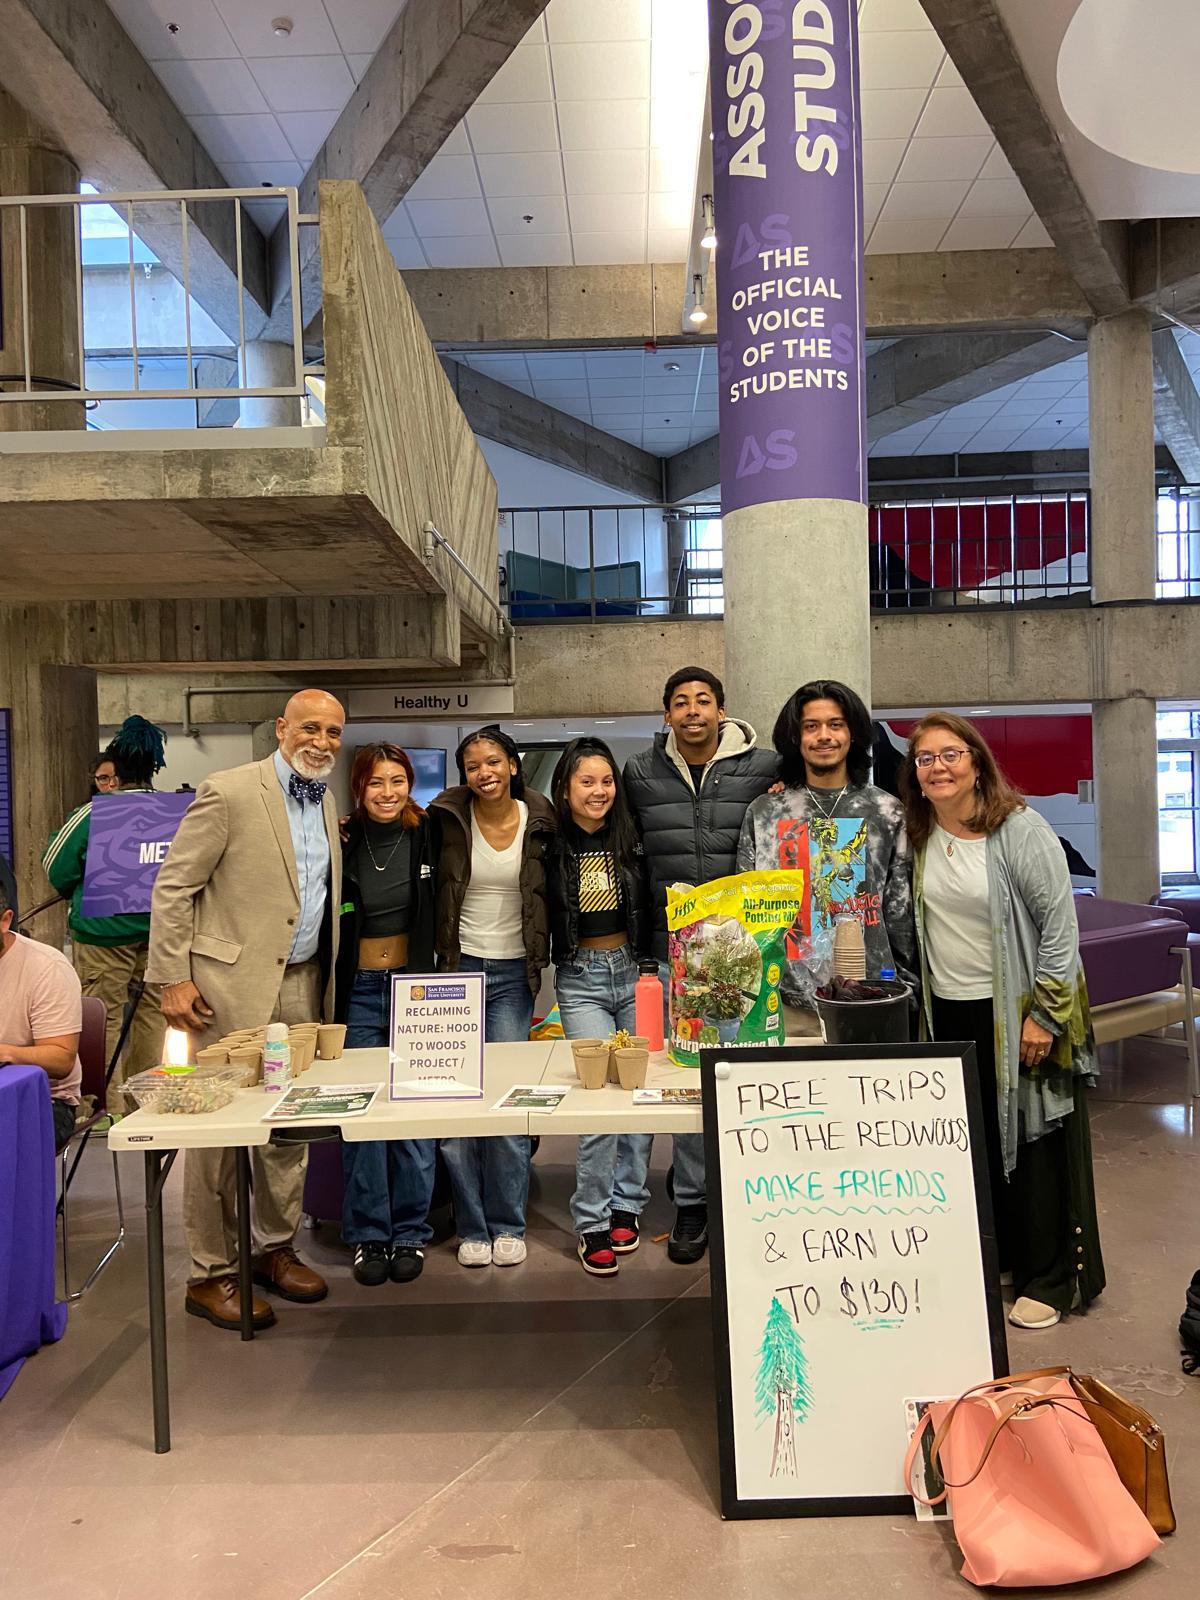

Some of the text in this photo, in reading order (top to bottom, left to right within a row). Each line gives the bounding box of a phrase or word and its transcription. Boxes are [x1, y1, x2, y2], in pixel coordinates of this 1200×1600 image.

[724, 0, 767, 179] ASSO
[758, 246, 809, 271] THE
[731, 277, 842, 311] OFFICIAL
[747, 308, 825, 335] VOICE
[742, 344, 774, 367] OF
[782, 339, 832, 360] THE
[730, 369, 848, 403] STUDENTS
[394, 694, 469, 710] Healthy U
[671, 898, 697, 920] Jiffy
[743, 898, 800, 910] All-Purpose
[745, 911, 780, 923] Potting
[405, 1006, 471, 1017] RECLAIMING
[397, 1023, 478, 1034] NATURE: HOOD
[408, 1041, 466, 1051] TO WOODS
[409, 1057, 465, 1069] PROJECT /
[737, 1078, 828, 1115] FREE
[725, 1117, 969, 1156] TO THE REDWOODS
[744, 1169, 947, 1204] MAKE FRIENDS
[764, 1225, 928, 1263] & EARN UP
[775, 1276, 921, 1324] TO $130!
